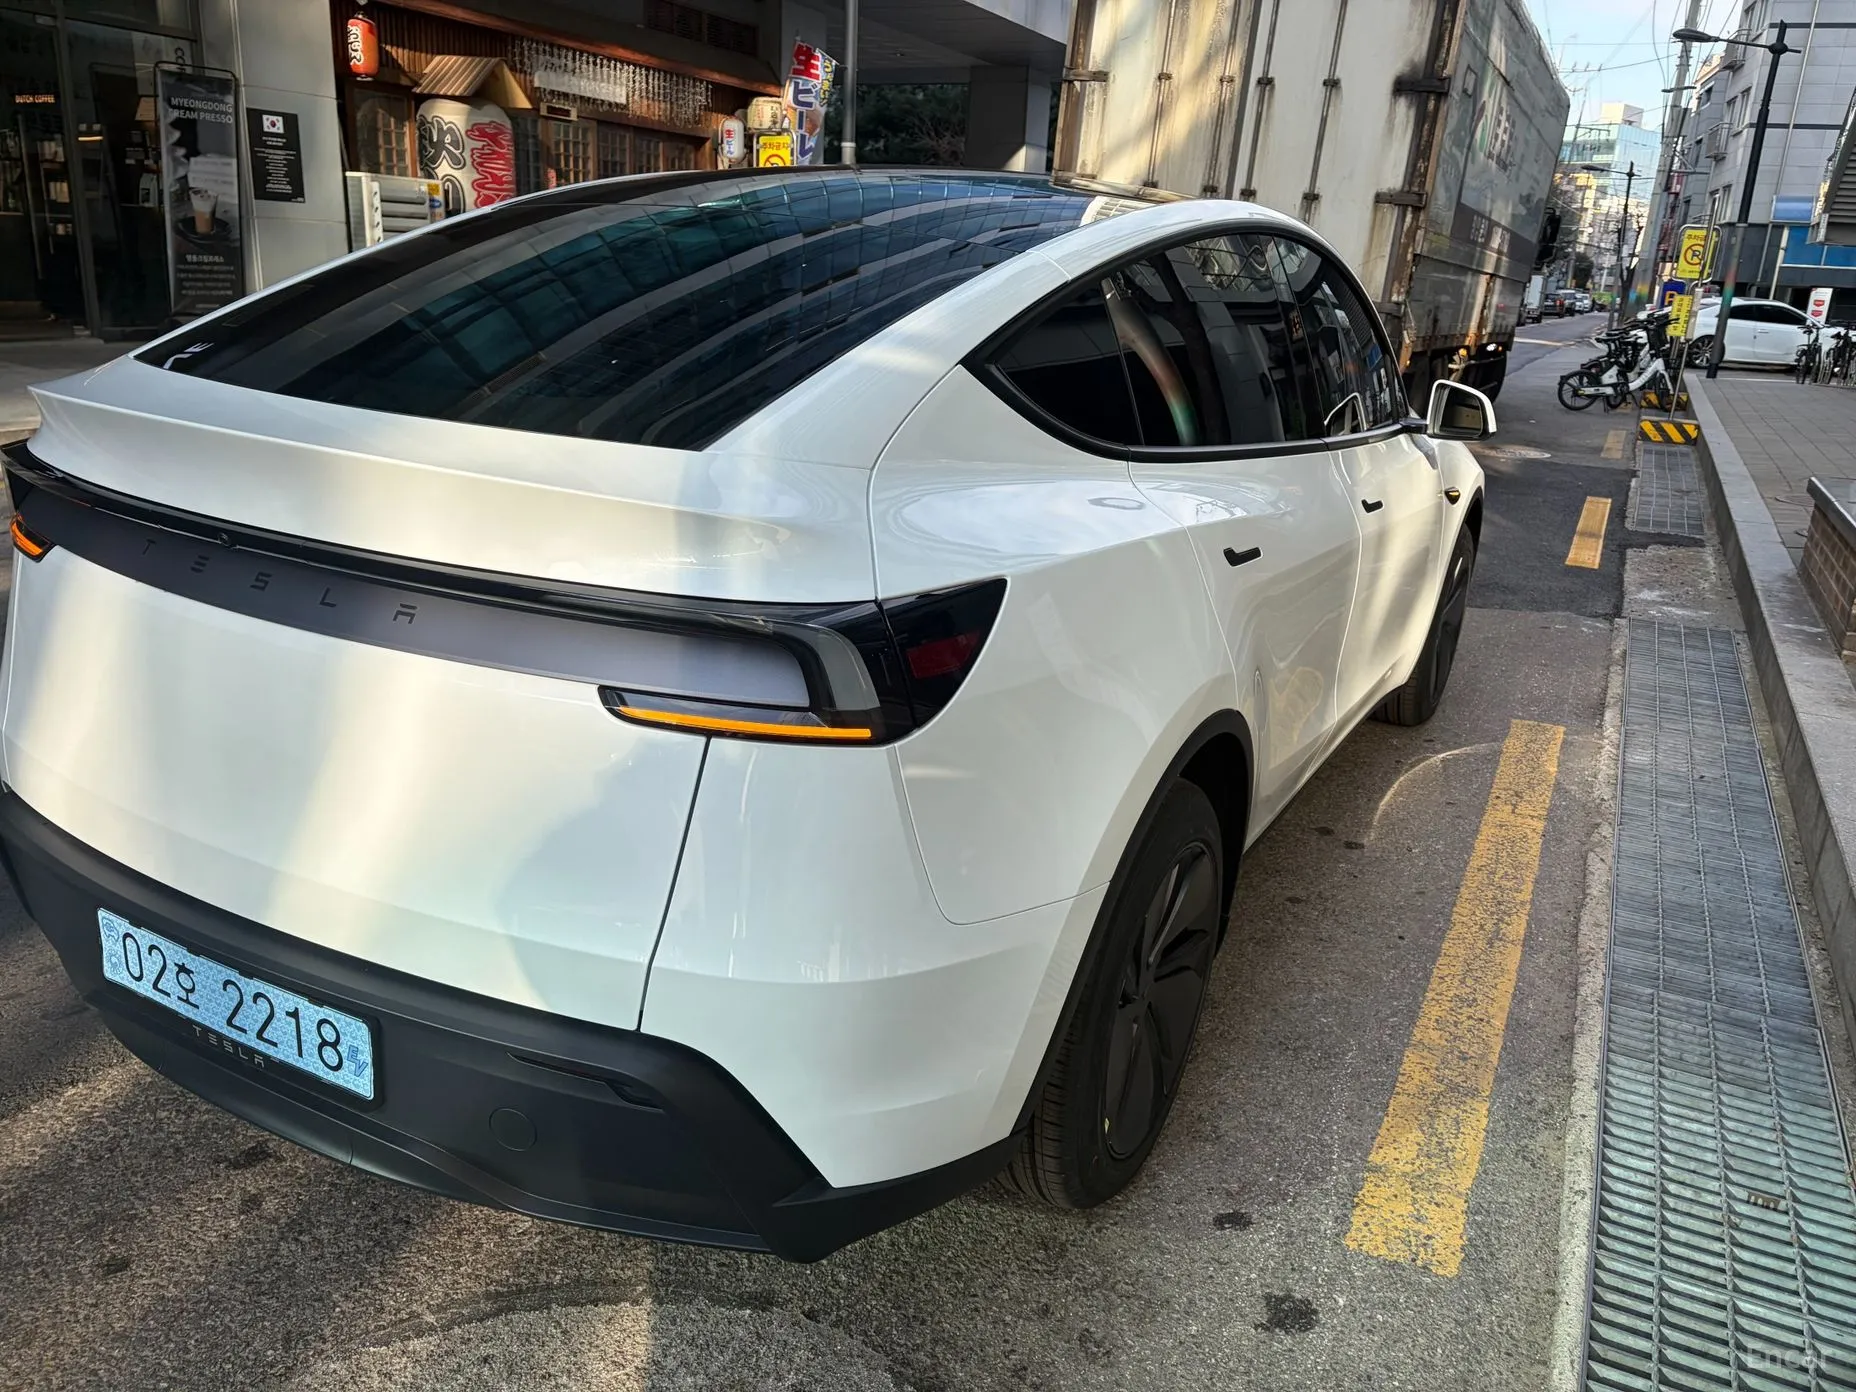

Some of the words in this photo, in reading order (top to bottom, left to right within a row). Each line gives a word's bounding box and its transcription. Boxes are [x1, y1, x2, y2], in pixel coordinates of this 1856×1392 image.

[15, 94, 34, 104] DUTCH
[34, 94, 56, 104] COFFEE
[171, 96, 233, 113] MYEONGDONG
[168, 108, 198, 120] CREAM
[199, 111, 233, 124] PRESSO
[762, 141, 791, 151] 주차금지
[141, 538, 418, 625] TESLA
[122, 932, 200, 1009] 02호
[222, 979, 344, 1073] 2218
[192, 1024, 266, 1070] TESLA
[346, 1044, 369, 1078] EV
